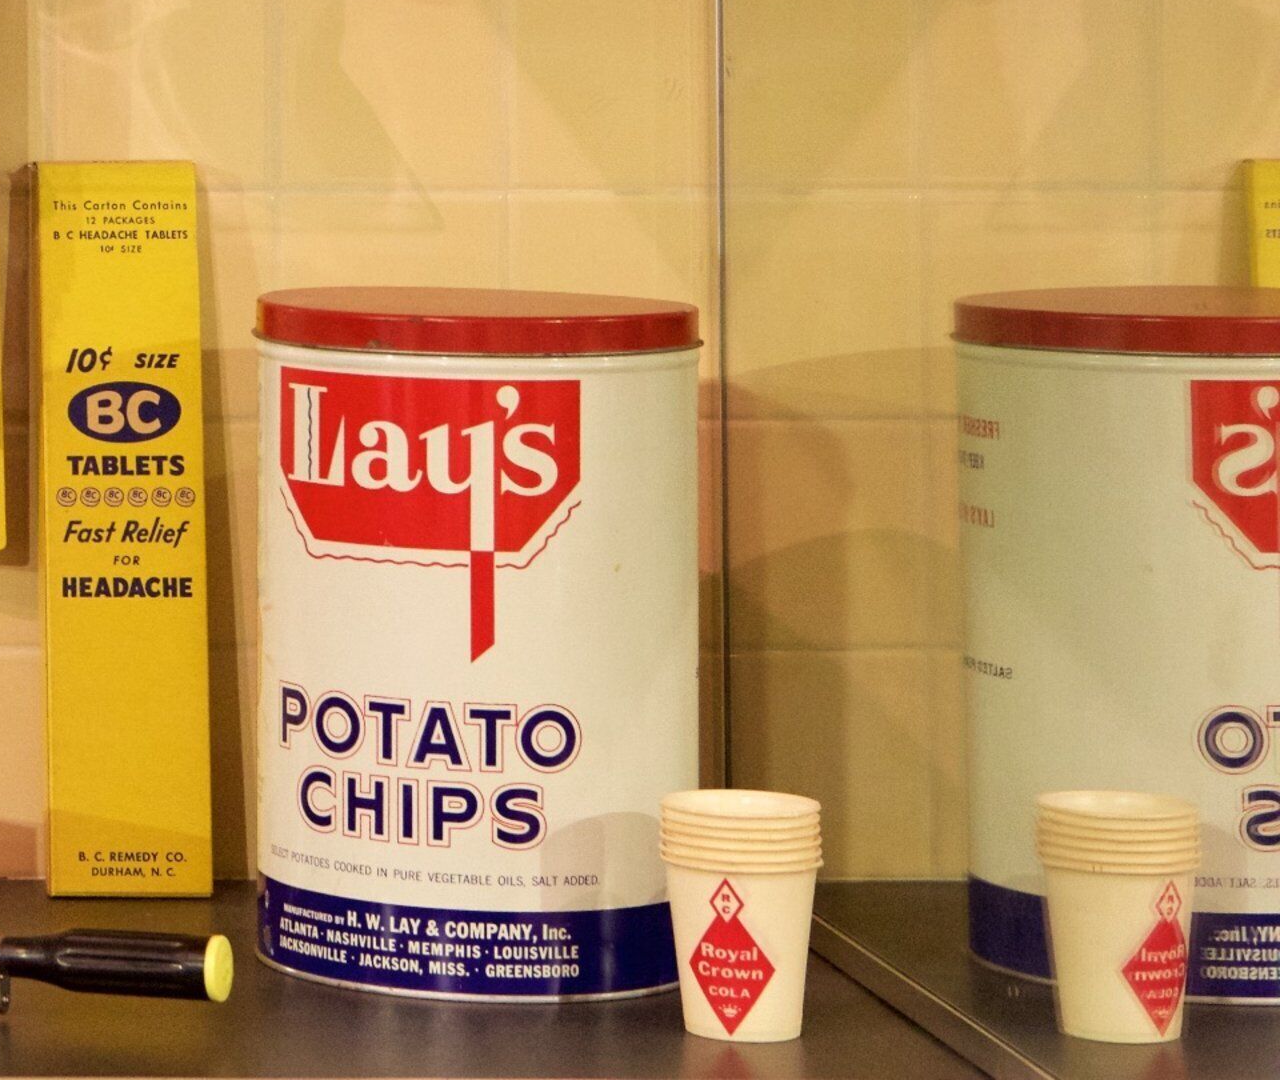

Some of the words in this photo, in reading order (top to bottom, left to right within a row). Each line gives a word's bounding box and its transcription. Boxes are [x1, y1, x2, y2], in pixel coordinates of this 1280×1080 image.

[53, 201, 77, 211] This
[83, 200, 126, 211] Carton
[132, 200, 188, 211] Contains
[86, 217, 96, 225] 12
[103, 216, 156, 225] PACKAGES
[79, 230, 138, 240] HEADACHE
[145, 230, 188, 240] TABLETS
[121, 245, 142, 253] SIZE
[65, 346, 113, 373] 10¢
[134, 353, 180, 369] SIZE
[86, 389, 162, 434] BC
[66, 455, 185, 476] TABLETS
[288, 383, 558, 552] Lay's
[63, 520, 116, 543] Fast
[121, 517, 190, 548] Relief
[113, 556, 140, 565] FOR
[62, 577, 193, 598] HEADACHE
[279, 681, 582, 772] POTATO
[298, 766, 547, 850] CHIPS
[78, 852, 89, 862] B.
[94, 852, 104, 862] C.
[109, 852, 158, 862] REMEDY
[165, 852, 187, 862] CO.
[271, 844, 289, 858] SELECT
[291, 852, 330, 869] POTATOES
[334, 860, 372, 875] COOKED
[376, 868, 388, 877] IN
[393, 869, 421, 881] PURE
[427, 873, 491, 886] VEGETABLE
[532, 876, 557, 887] SALT
[563, 875, 600, 886] ADDED.
[91, 868, 146, 877] DURHAM,
[283, 903, 332, 923] MANUFACTURED
[334, 915, 344, 925] BY
[347, 909, 362, 928] H.
[365, 912, 385, 931] W.
[390, 916, 420, 935] LAY
[425, 919, 440, 937] &
[444, 921, 538, 944] COMPANY,
[542, 923, 572, 940] Inc.
[279, 917, 319, 940] ATLANTA
[326, 929, 396, 952] NASHVILLE
[408, 940, 481, 959] MEMPHIS
[494, 945, 580, 960] LOUISVILLE
[279, 934, 348, 964] JACKSONVILLE
[358, 953, 423, 976] JACKSON,
[428, 960, 470, 977] MISS.
[485, 964, 580, 978] GREENSBORO
[700, 942, 758, 963] Royal
[697, 960, 764, 980] Crown
[708, 985, 751, 999] COLA
